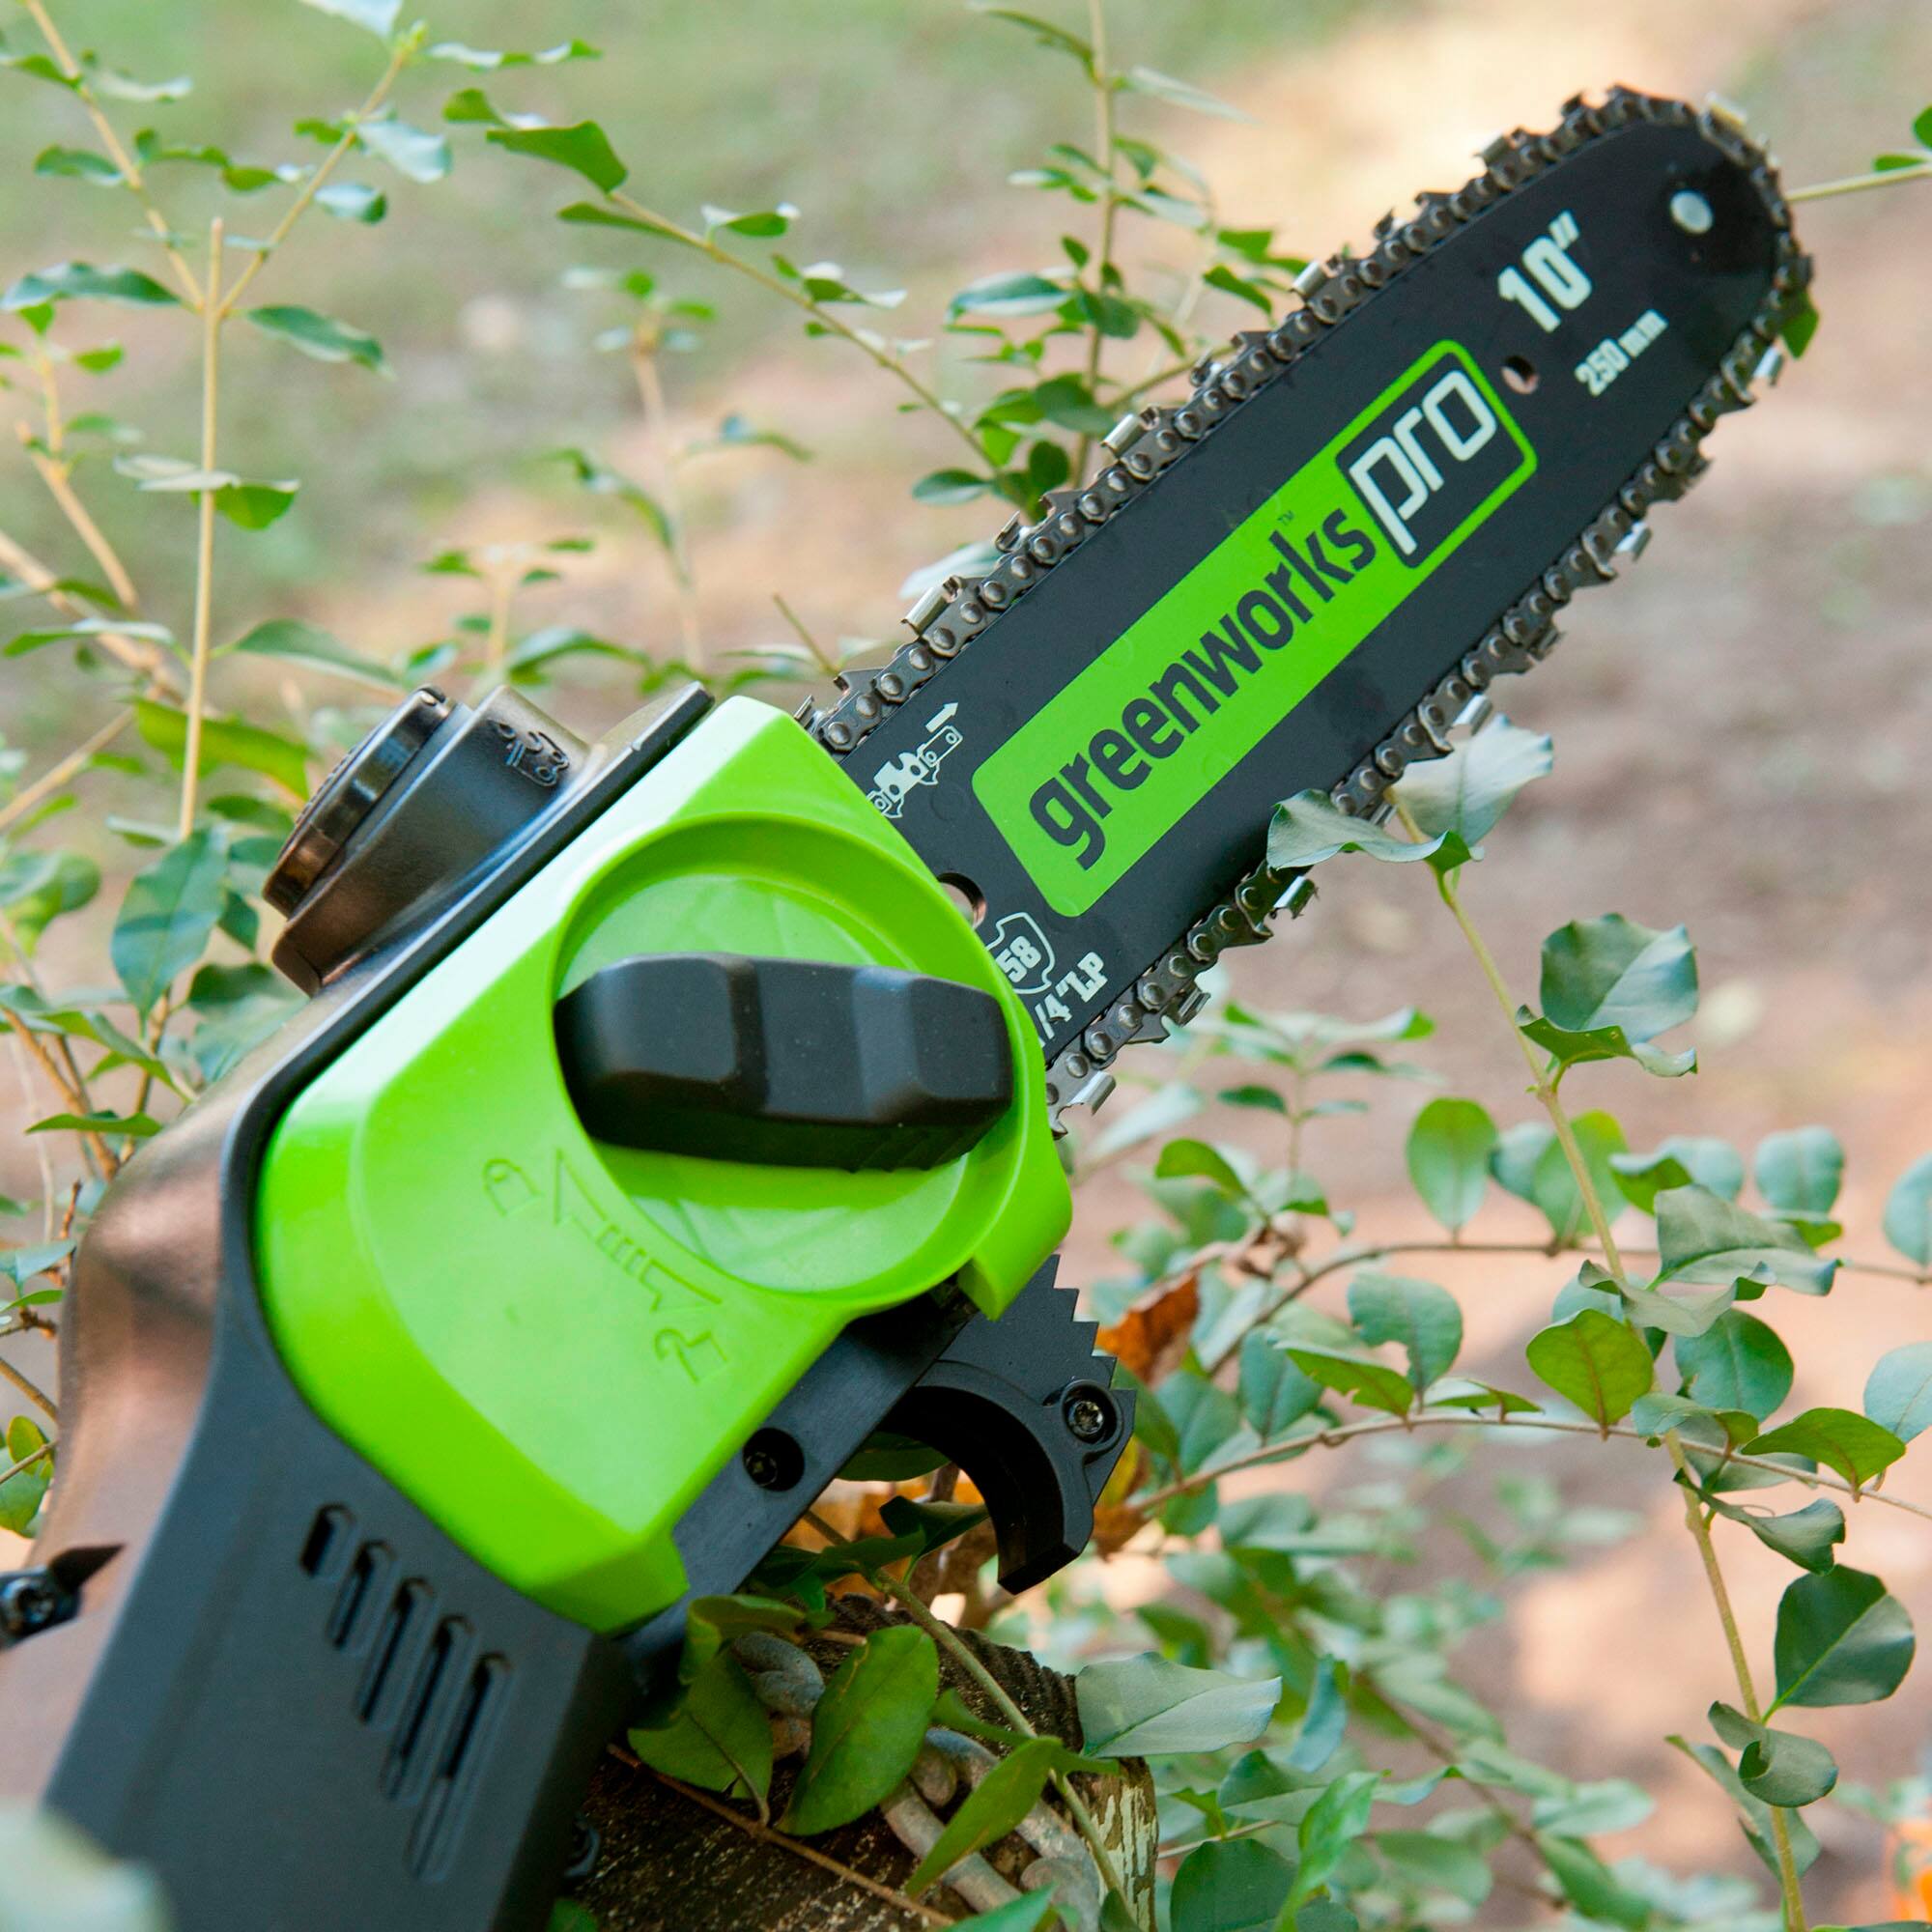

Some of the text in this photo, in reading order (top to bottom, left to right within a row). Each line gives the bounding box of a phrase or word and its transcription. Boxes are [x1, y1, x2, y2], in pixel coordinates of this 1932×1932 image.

[1498, 209, 1592, 332] 10"
[1574, 308, 1669, 397] 250 mm
[1029, 508, 1377, 870] greenworks
[1349, 370, 1498, 555] pro
[995, 935, 1042, 983] 58
